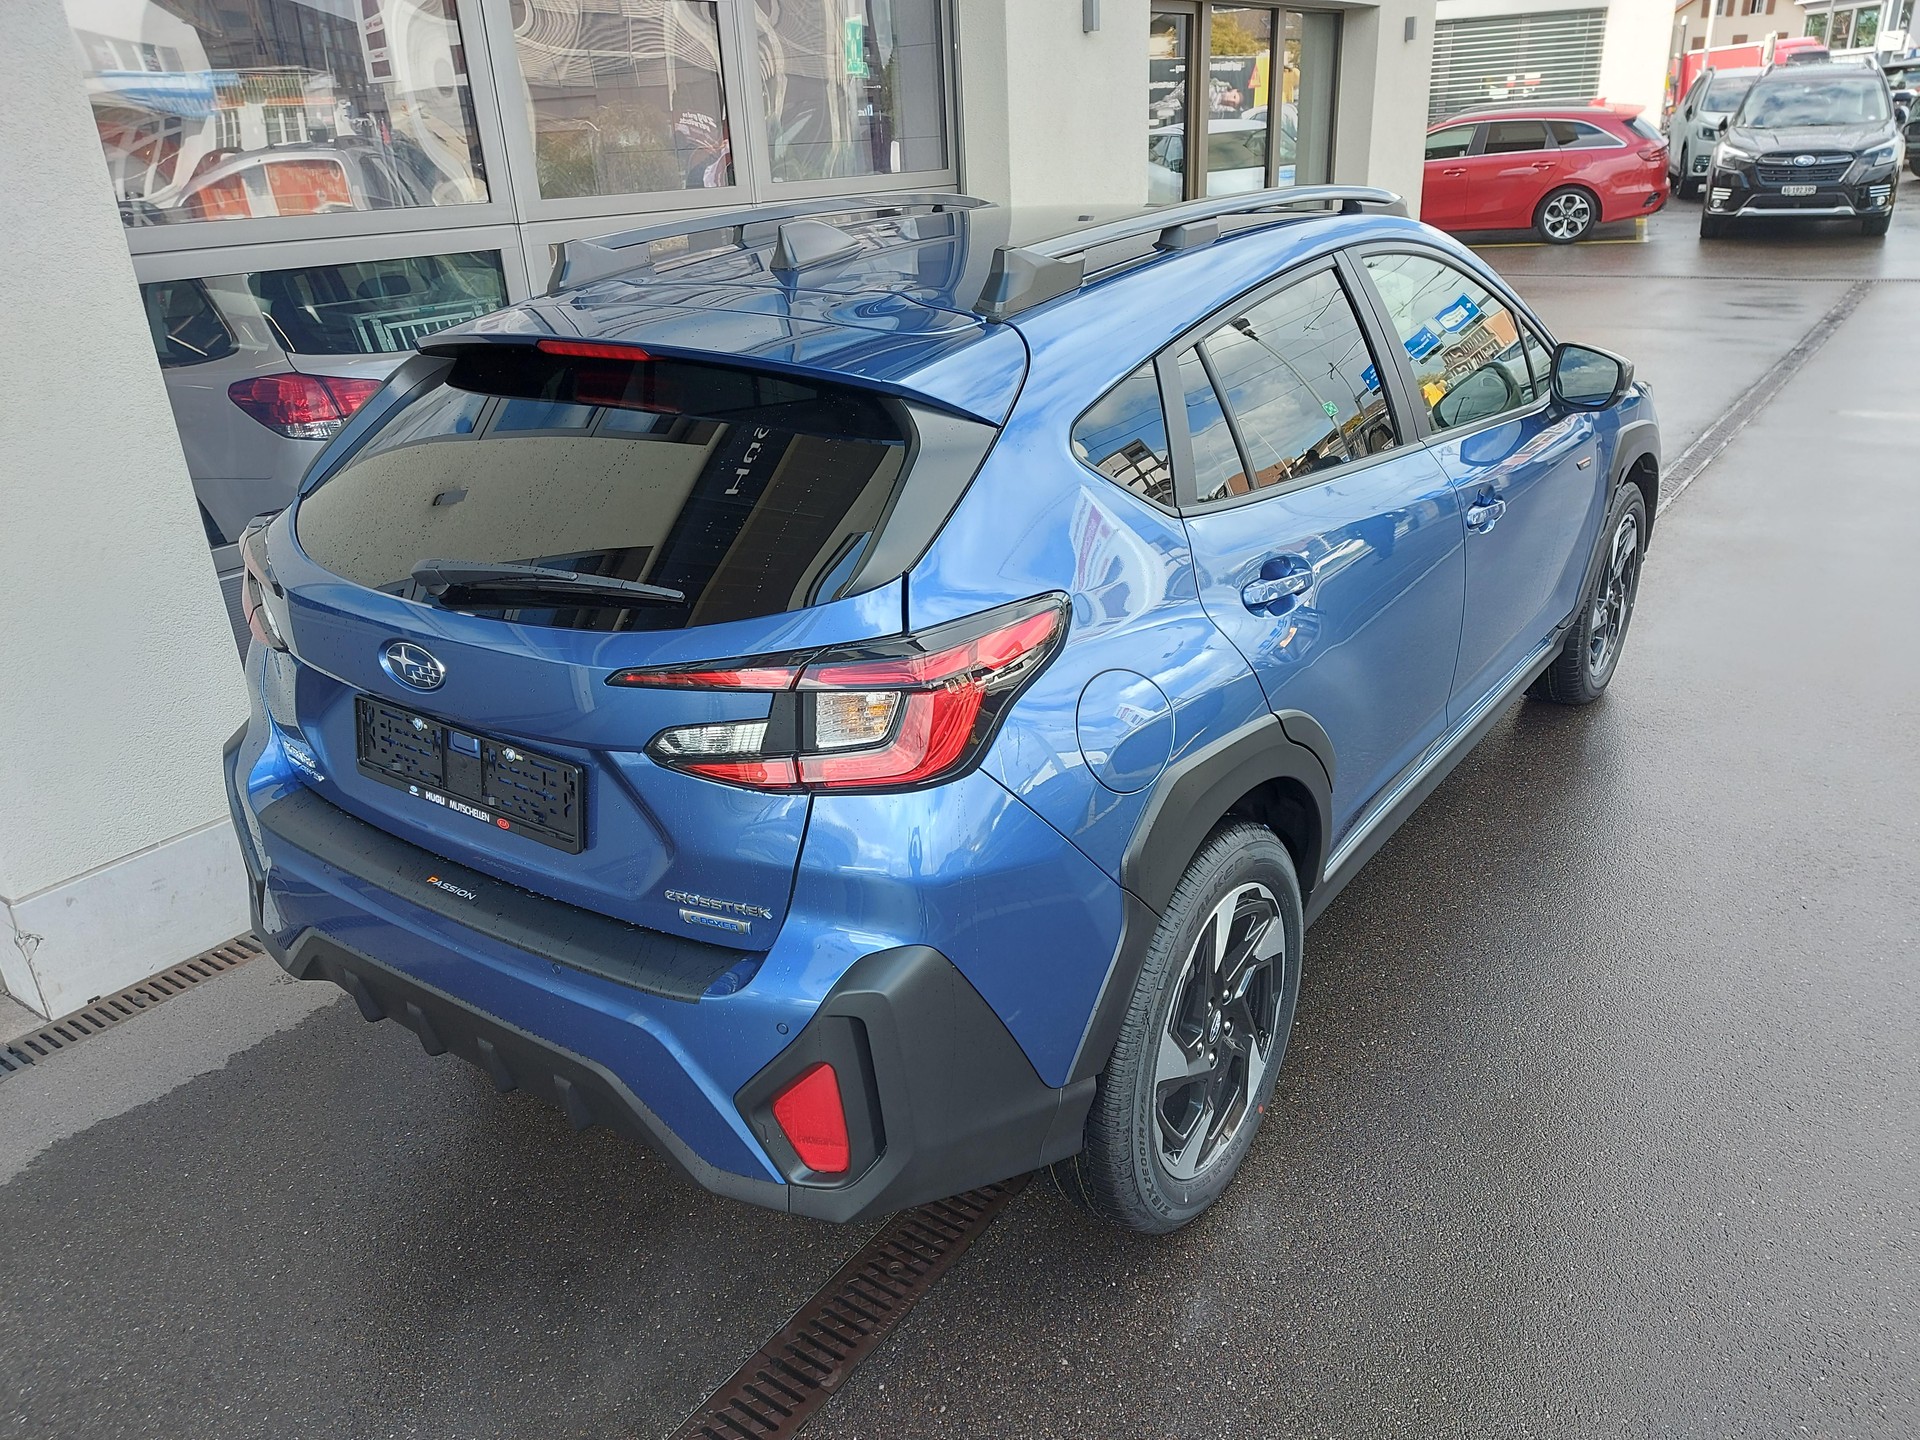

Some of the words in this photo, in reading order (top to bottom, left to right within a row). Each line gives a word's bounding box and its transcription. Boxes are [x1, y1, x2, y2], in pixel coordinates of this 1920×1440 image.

[449, 799, 490, 823] MUTSCHELLEN
[426, 876, 477, 901] PASSION
[664, 889, 773, 920] CROSSTREK
